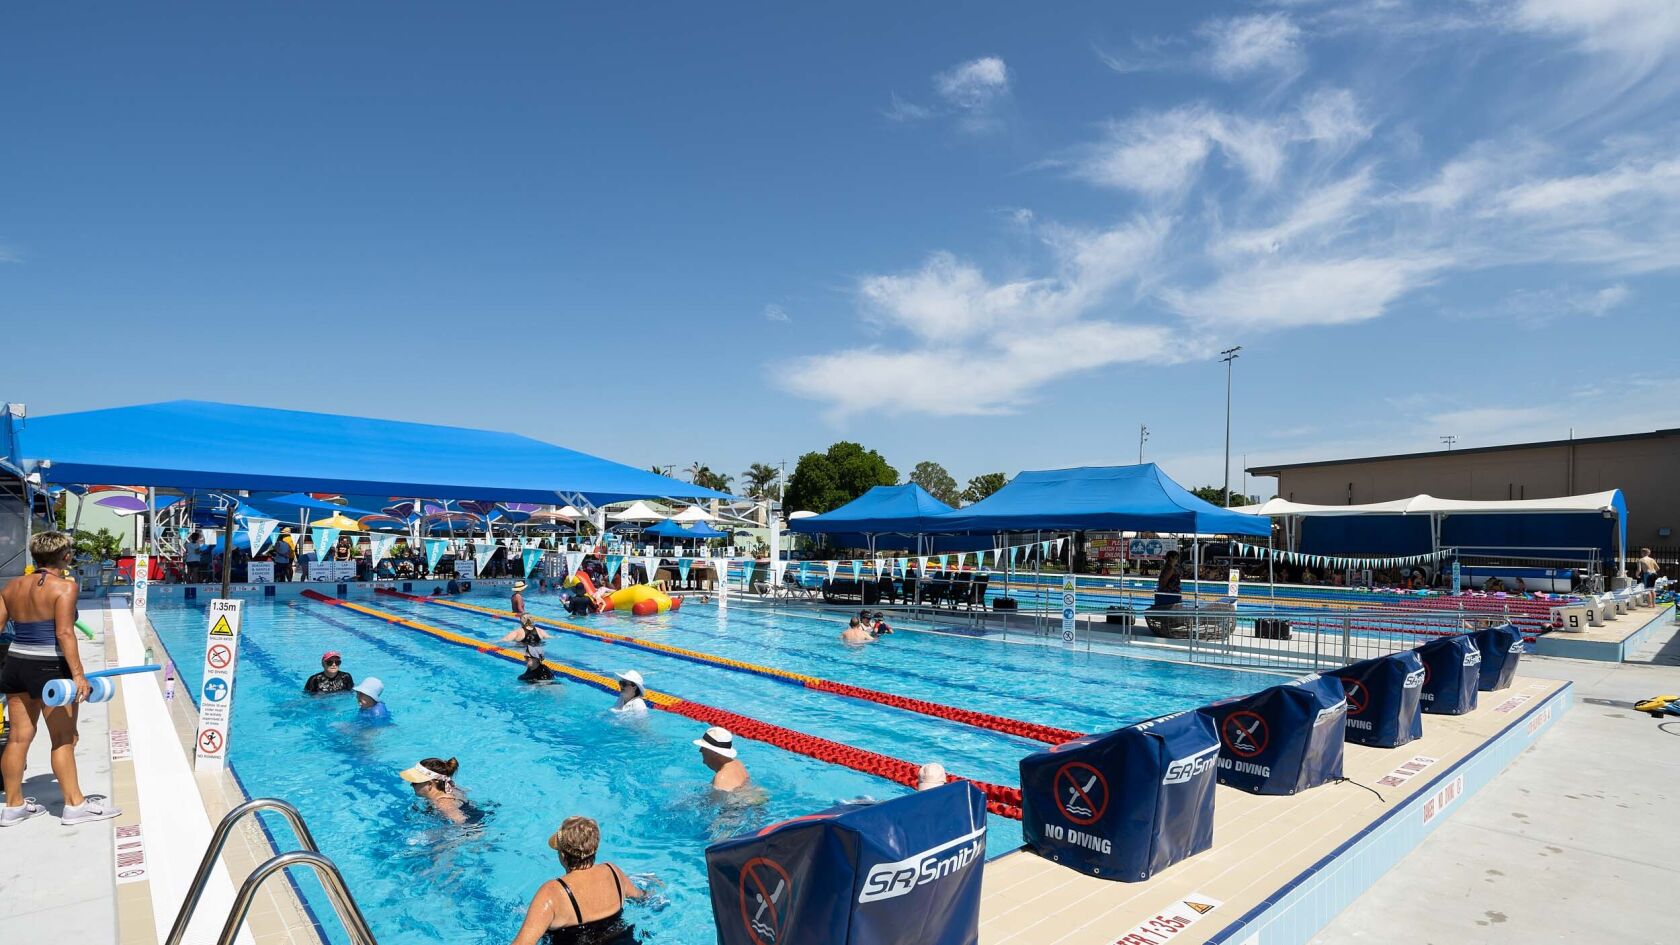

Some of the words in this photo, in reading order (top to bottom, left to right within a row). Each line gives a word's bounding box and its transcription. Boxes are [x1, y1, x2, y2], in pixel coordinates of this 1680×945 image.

[213, 602, 236, 611] 1.35m
[1569, 615, 1578, 627] 9
[1217, 757, 1232, 770] NO
[1235, 760, 1271, 778] DIVING
[1045, 823, 1064, 840] NO
[1067, 829, 1112, 855] DIVING
